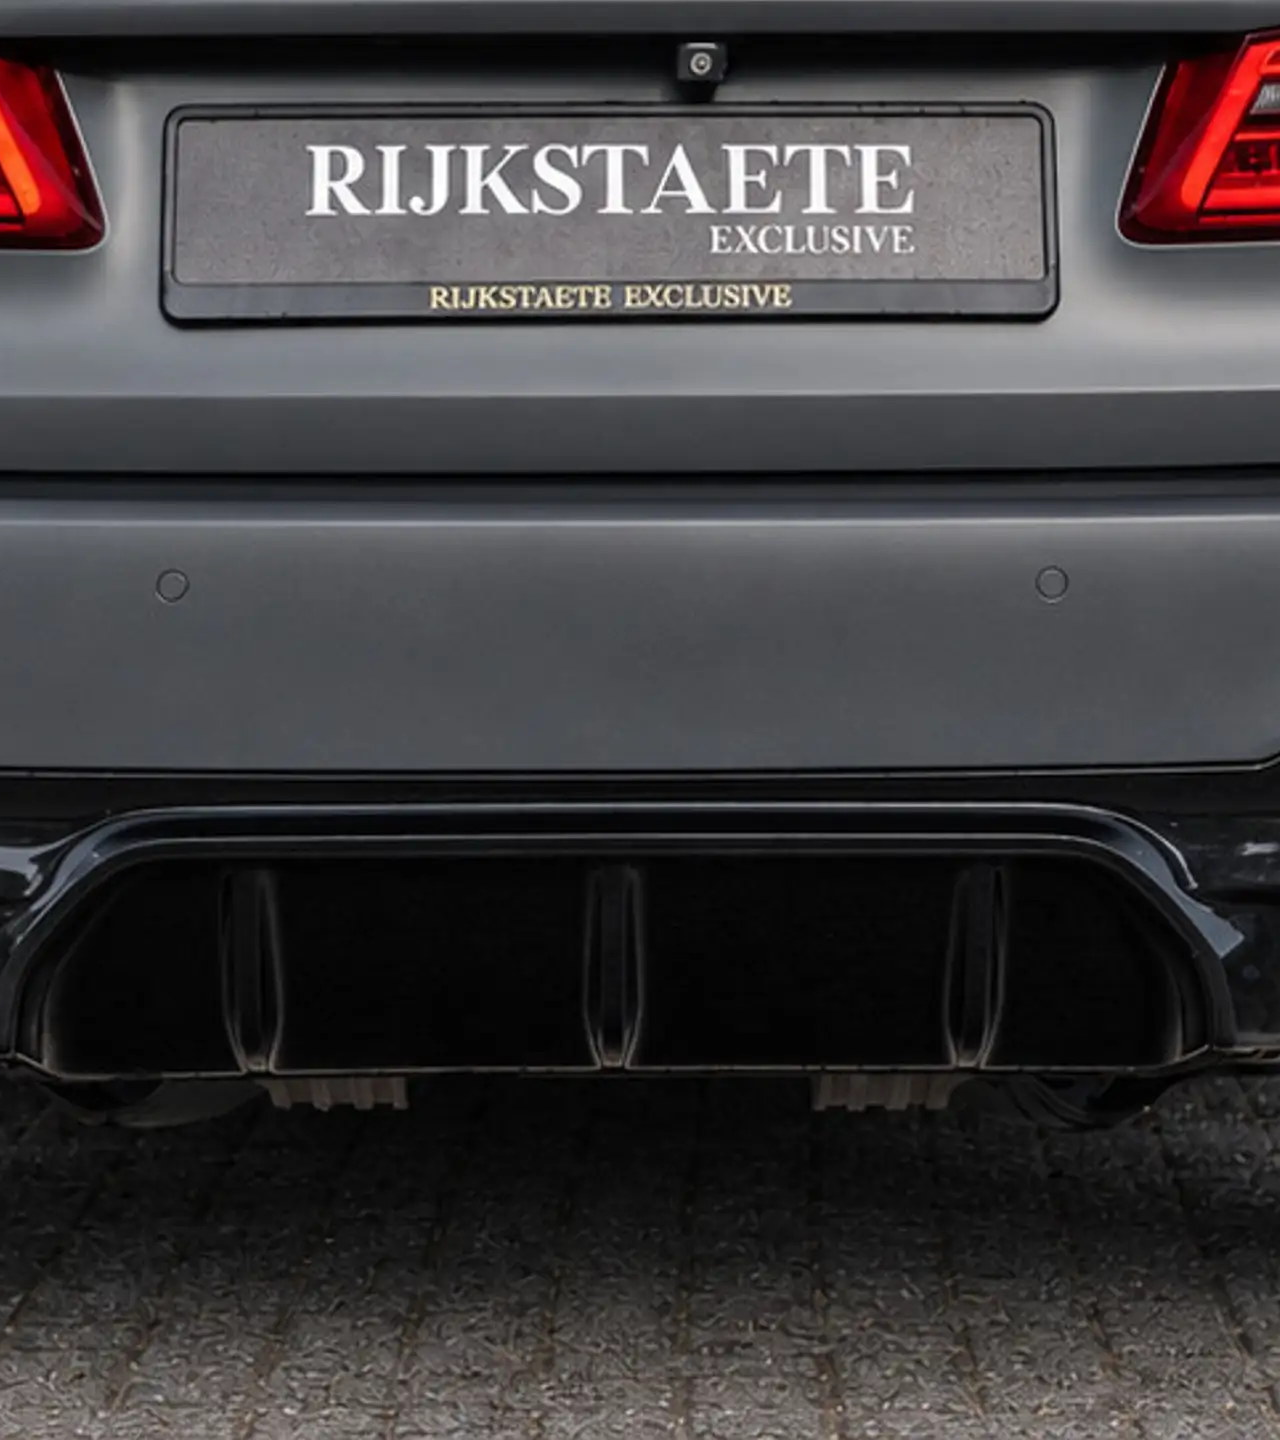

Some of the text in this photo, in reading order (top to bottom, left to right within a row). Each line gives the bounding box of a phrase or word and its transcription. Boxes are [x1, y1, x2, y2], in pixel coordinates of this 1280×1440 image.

[305, 144, 916, 216] RIJKSTAETE
[708, 224, 916, 255] EXCLUSIVE
[428, 285, 793, 311] RIJKSTAETE EXCLUSIVE
